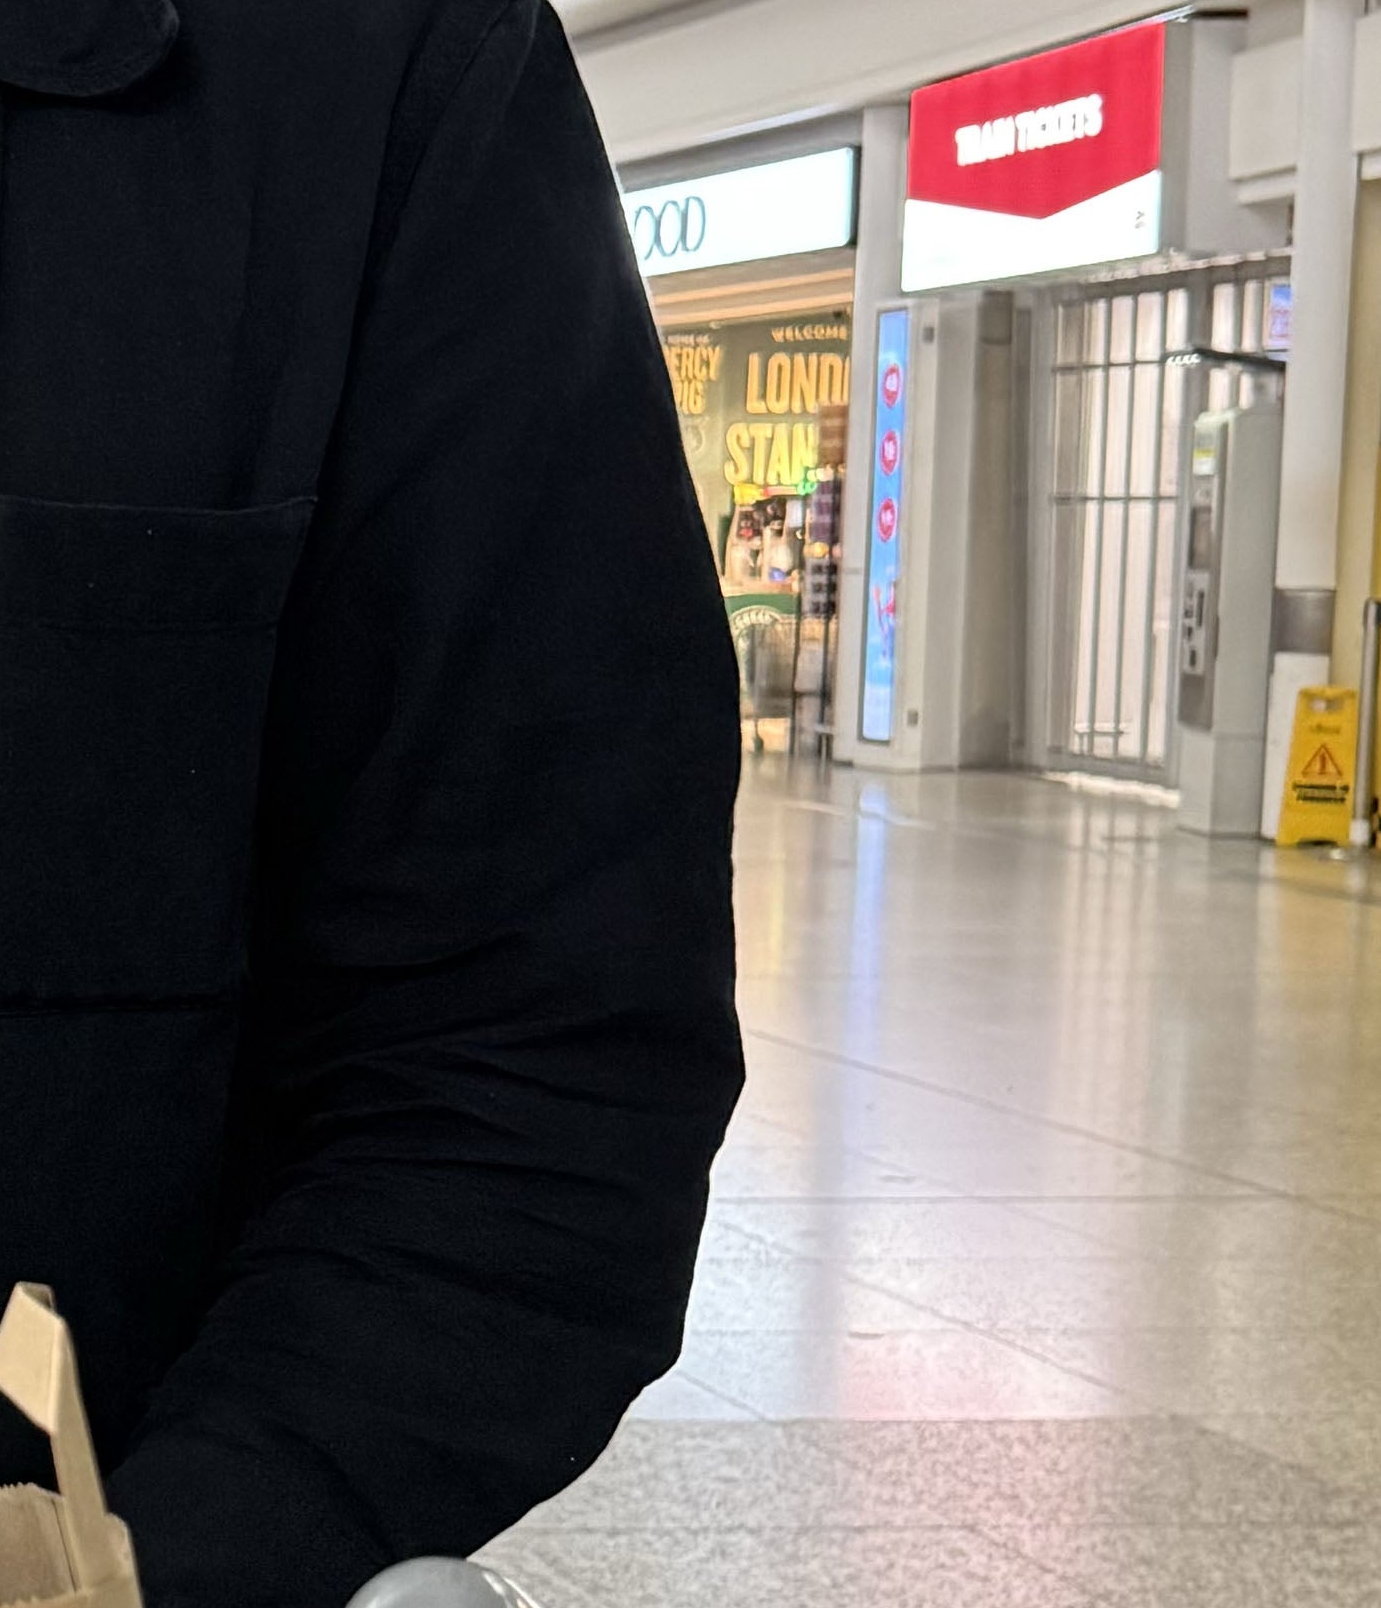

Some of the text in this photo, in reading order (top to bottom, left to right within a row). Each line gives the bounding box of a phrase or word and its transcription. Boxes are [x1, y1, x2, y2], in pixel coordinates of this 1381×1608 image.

[1015, 93, 1103, 152] TICKETS
[663, 345, 722, 382] ERCY
[745, 351, 851, 415] LOND
[676, 379, 706, 415] IG
